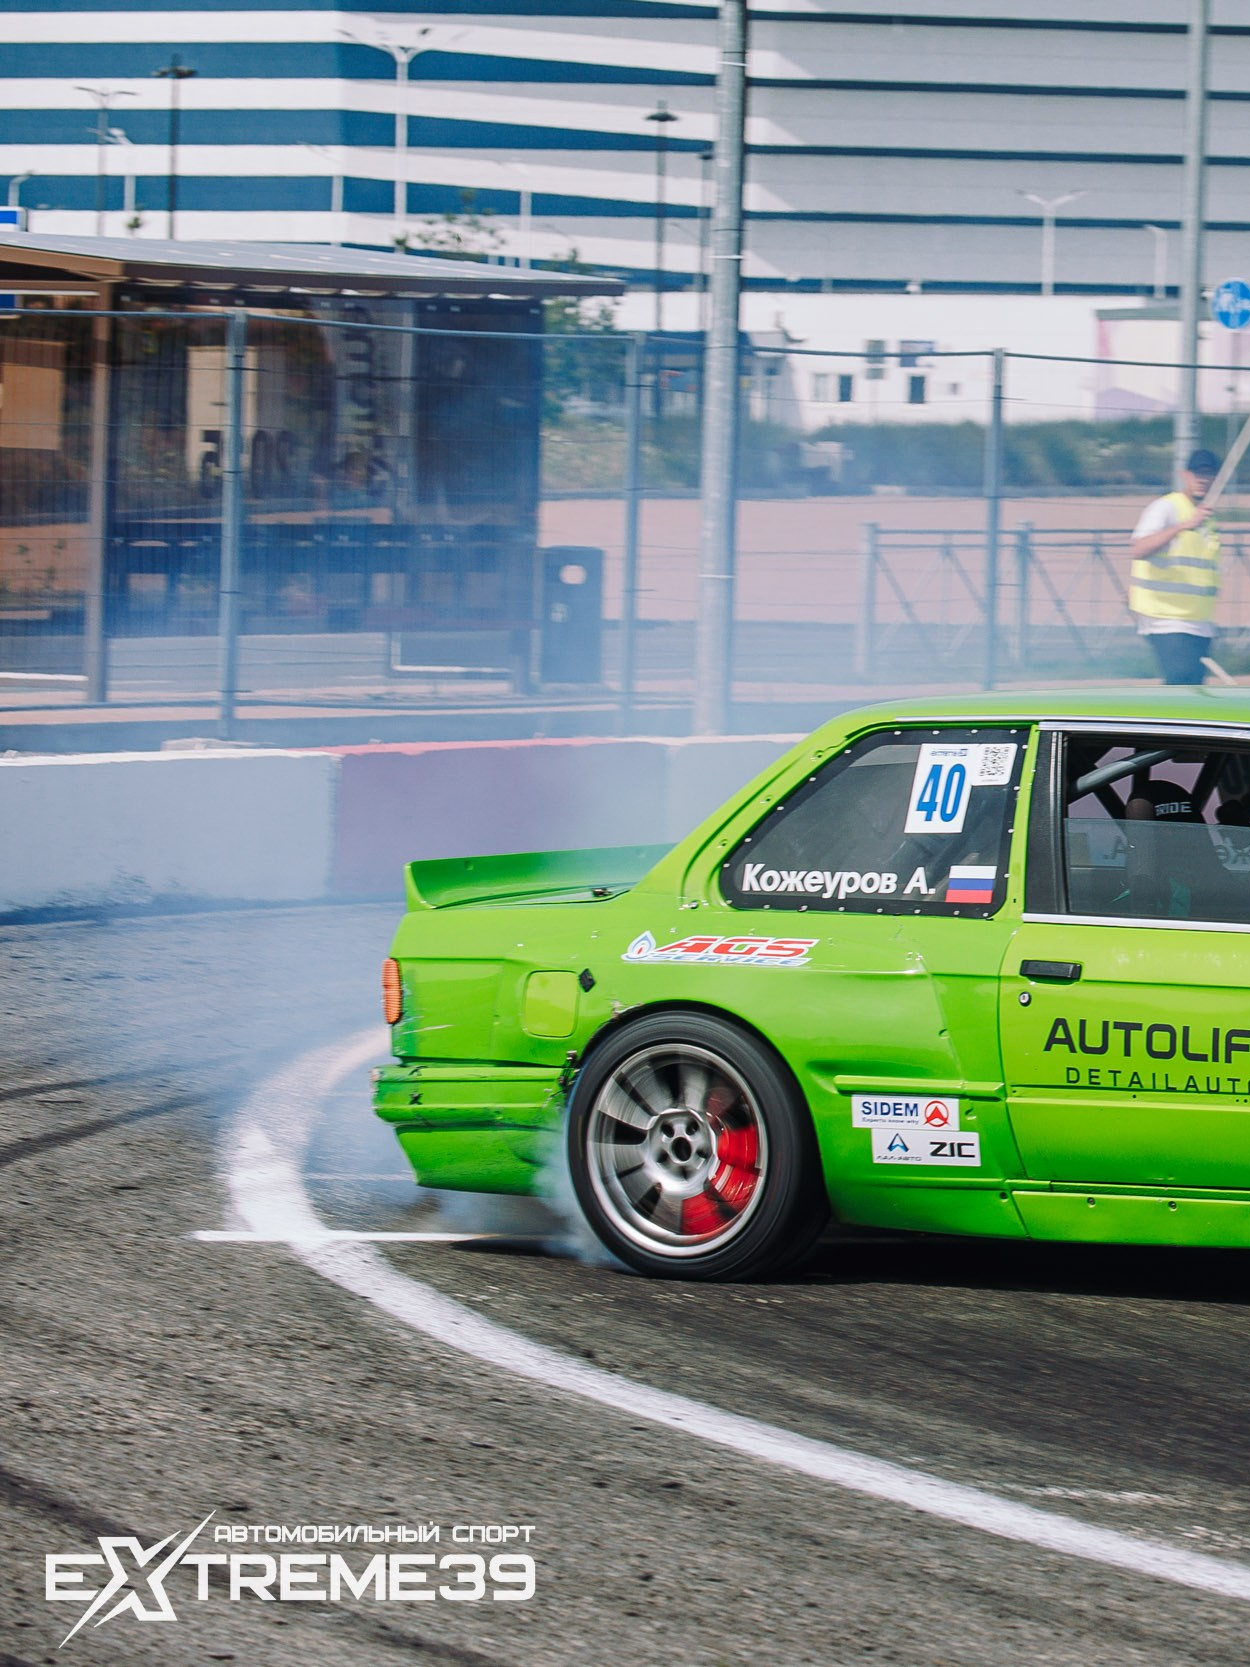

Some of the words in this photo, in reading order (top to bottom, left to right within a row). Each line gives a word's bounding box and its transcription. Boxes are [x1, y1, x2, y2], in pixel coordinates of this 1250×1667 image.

[916, 763, 966, 822] 40
[741, 863, 898, 899] Кожеуров
[903, 866, 937, 895] А.
[658, 937, 815, 957] AGS
[650, 954, 810, 965] SERVICE
[862, 1101, 919, 1117] SIDEM
[930, 1141, 976, 1158] ZIC
